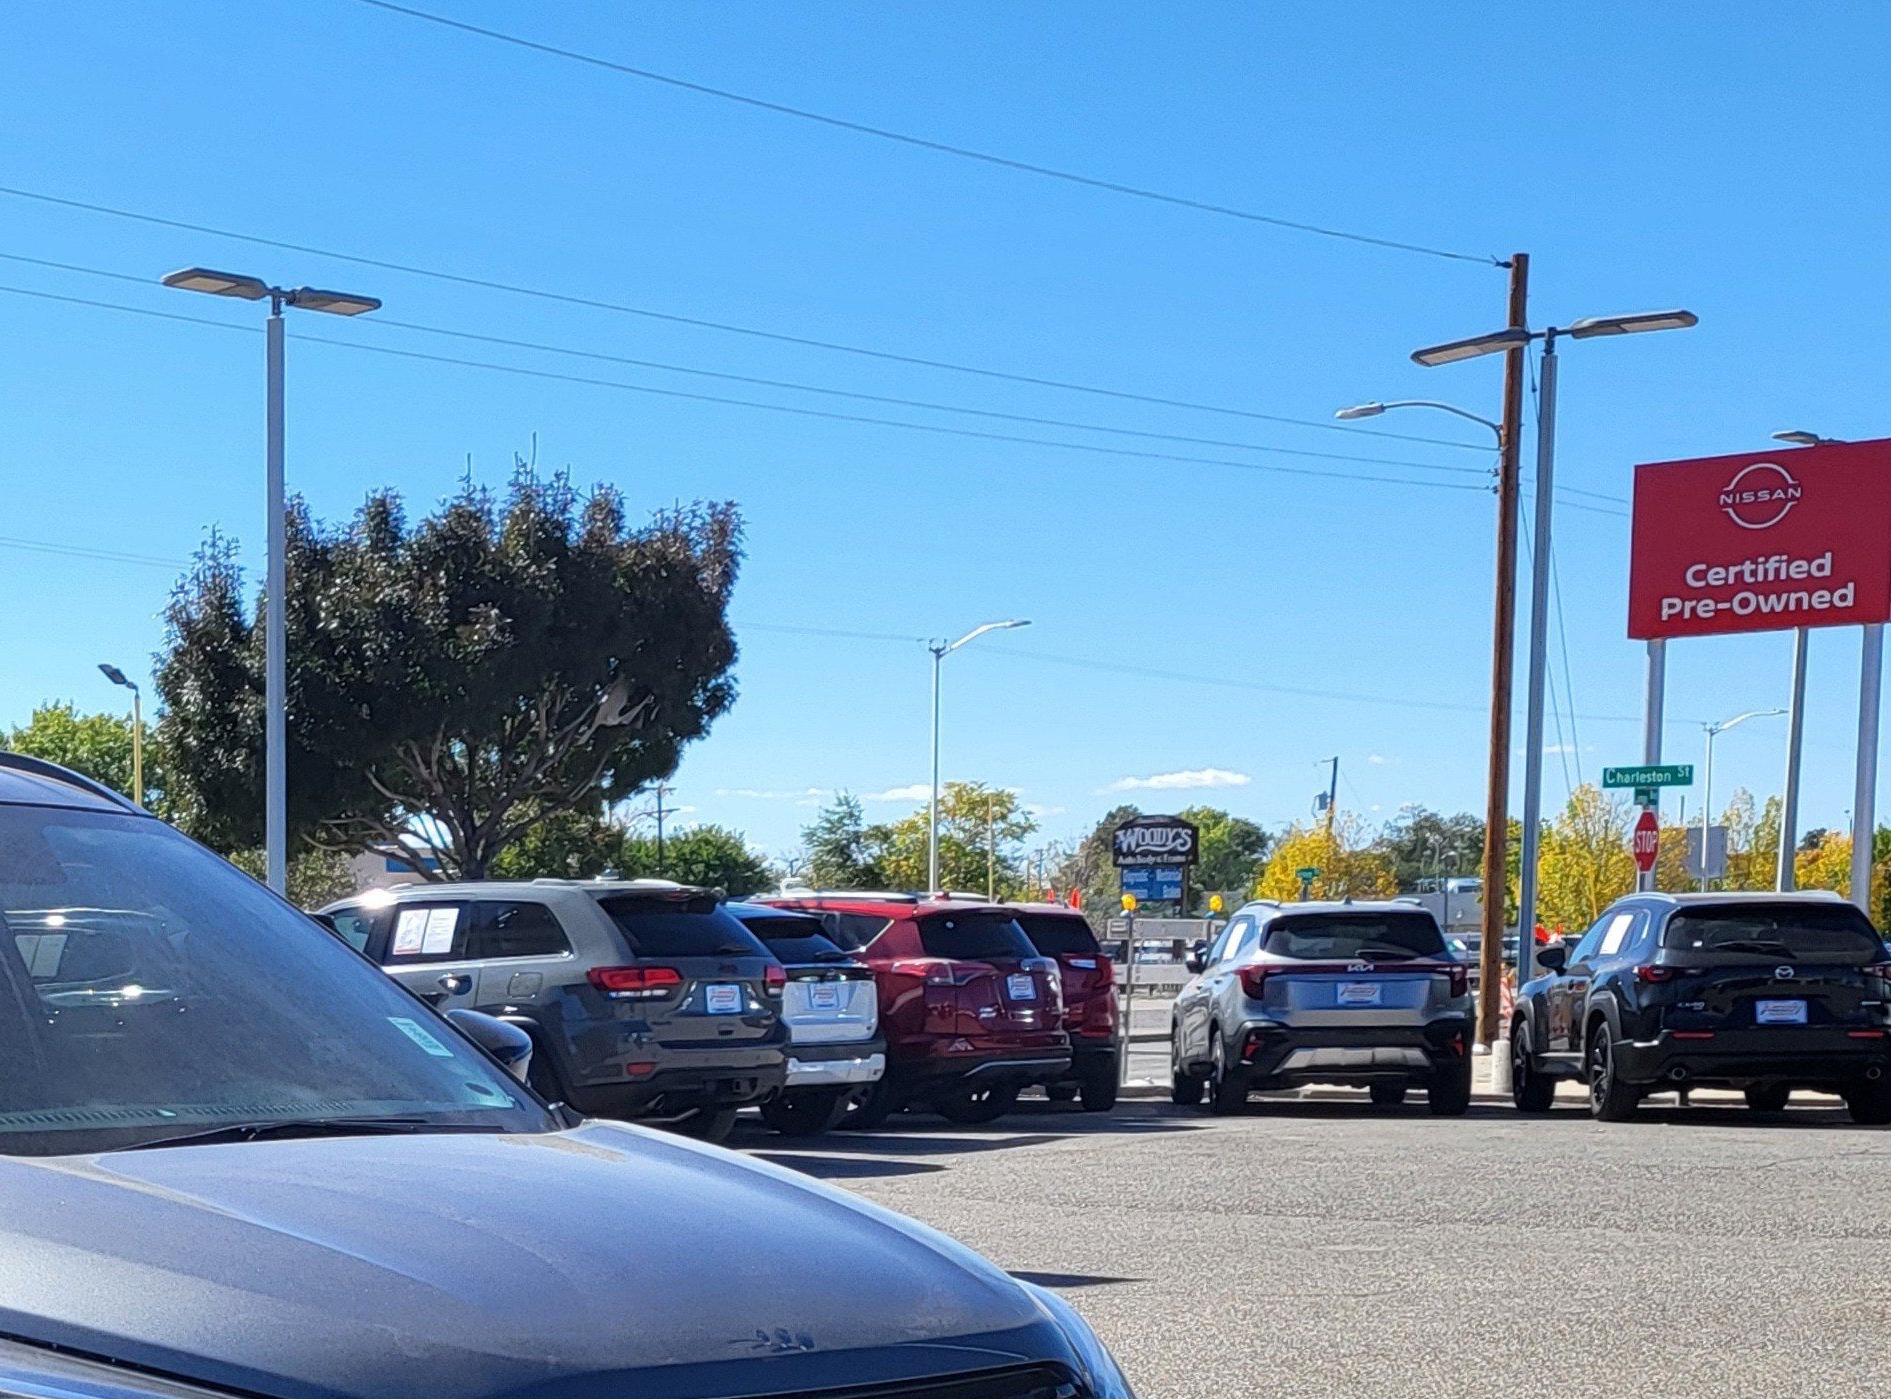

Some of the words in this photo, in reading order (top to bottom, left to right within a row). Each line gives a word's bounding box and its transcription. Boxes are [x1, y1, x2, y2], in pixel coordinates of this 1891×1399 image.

[1719, 486, 1802, 506] NISSAN
[1685, 551, 1833, 587] Certified
[1661, 582, 1855, 621] Pre-Owned
[1605, 768, 1672, 784] Charleston
[1677, 765, 1690, 777] St
[1114, 827, 1193, 853] WOODY'S
[1635, 830, 1658, 853] STOP
